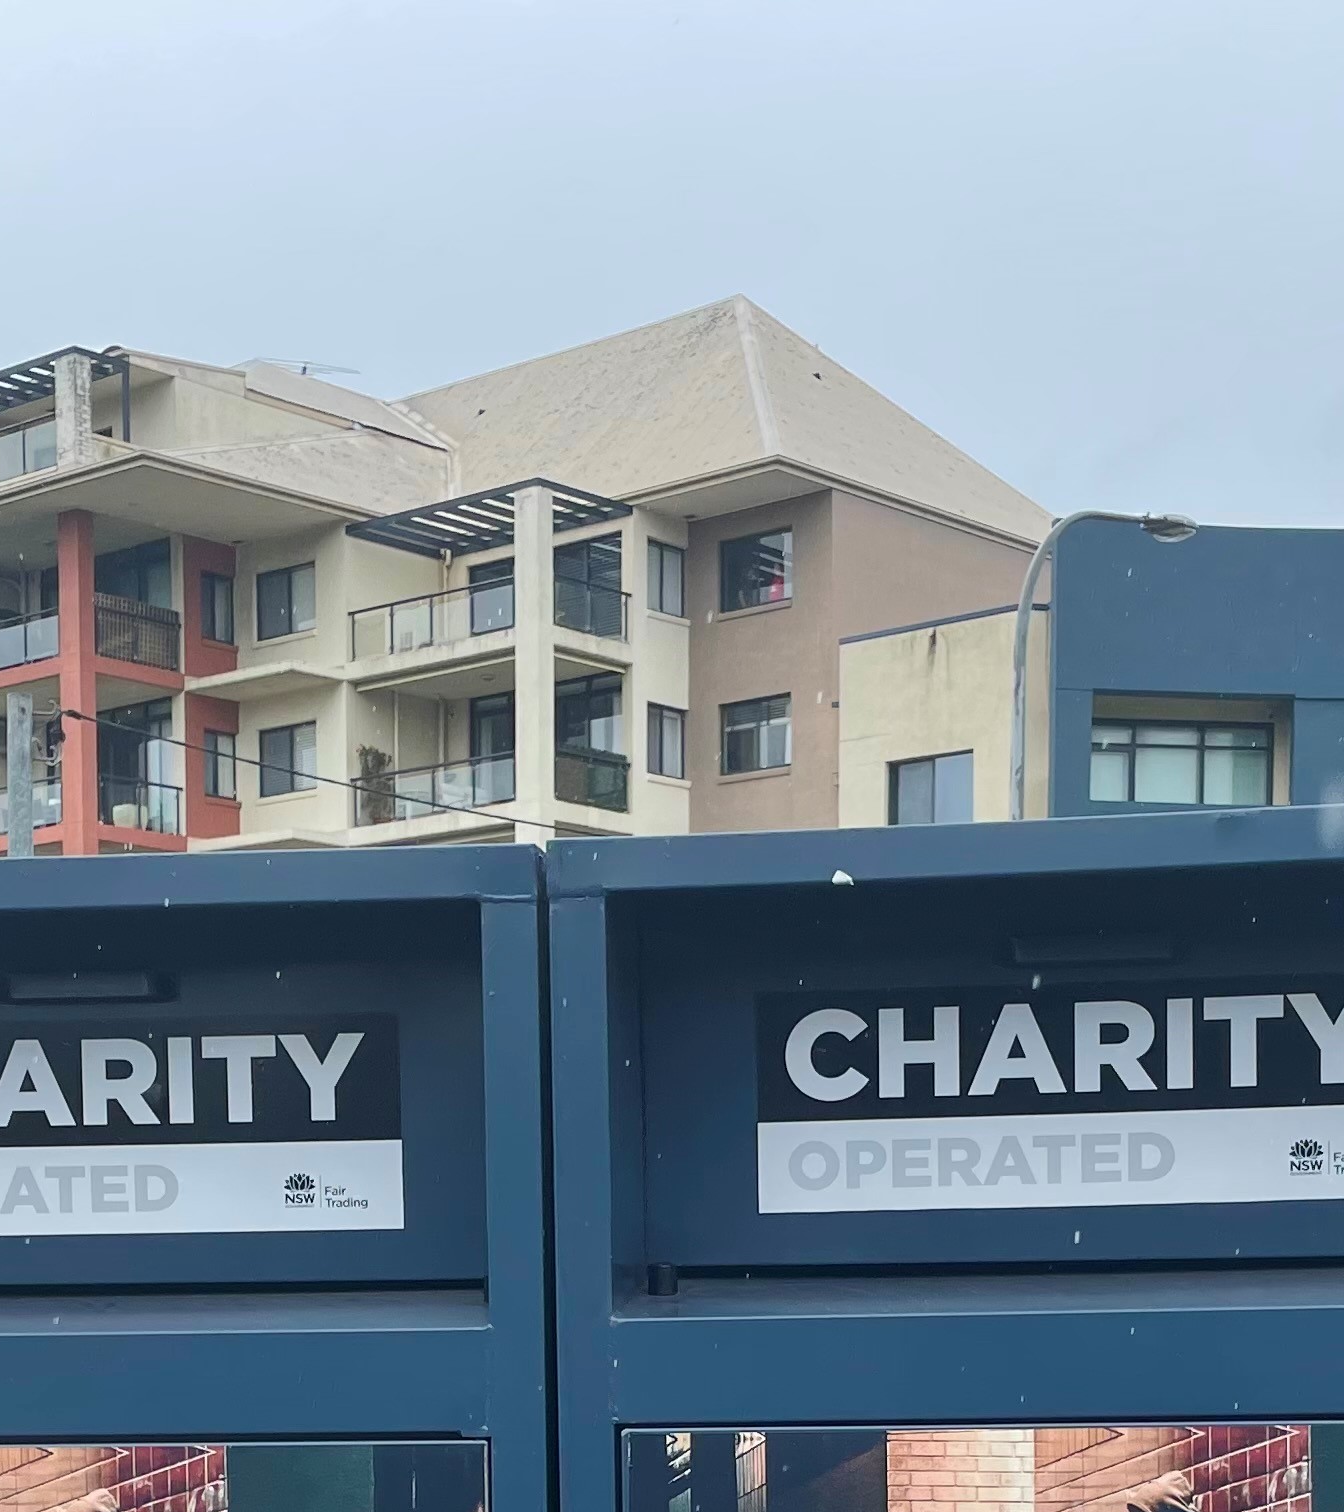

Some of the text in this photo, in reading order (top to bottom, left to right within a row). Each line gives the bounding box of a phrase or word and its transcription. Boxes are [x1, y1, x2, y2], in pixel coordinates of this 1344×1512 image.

[787, 1131, 1177, 1192] OPERATED
[1289, 1160, 1323, 1171] NSW
[324, 1186, 347, 1196] Fair
[285, 1193, 315, 1204] NSW
[325, 1198, 369, 1209] Trading
